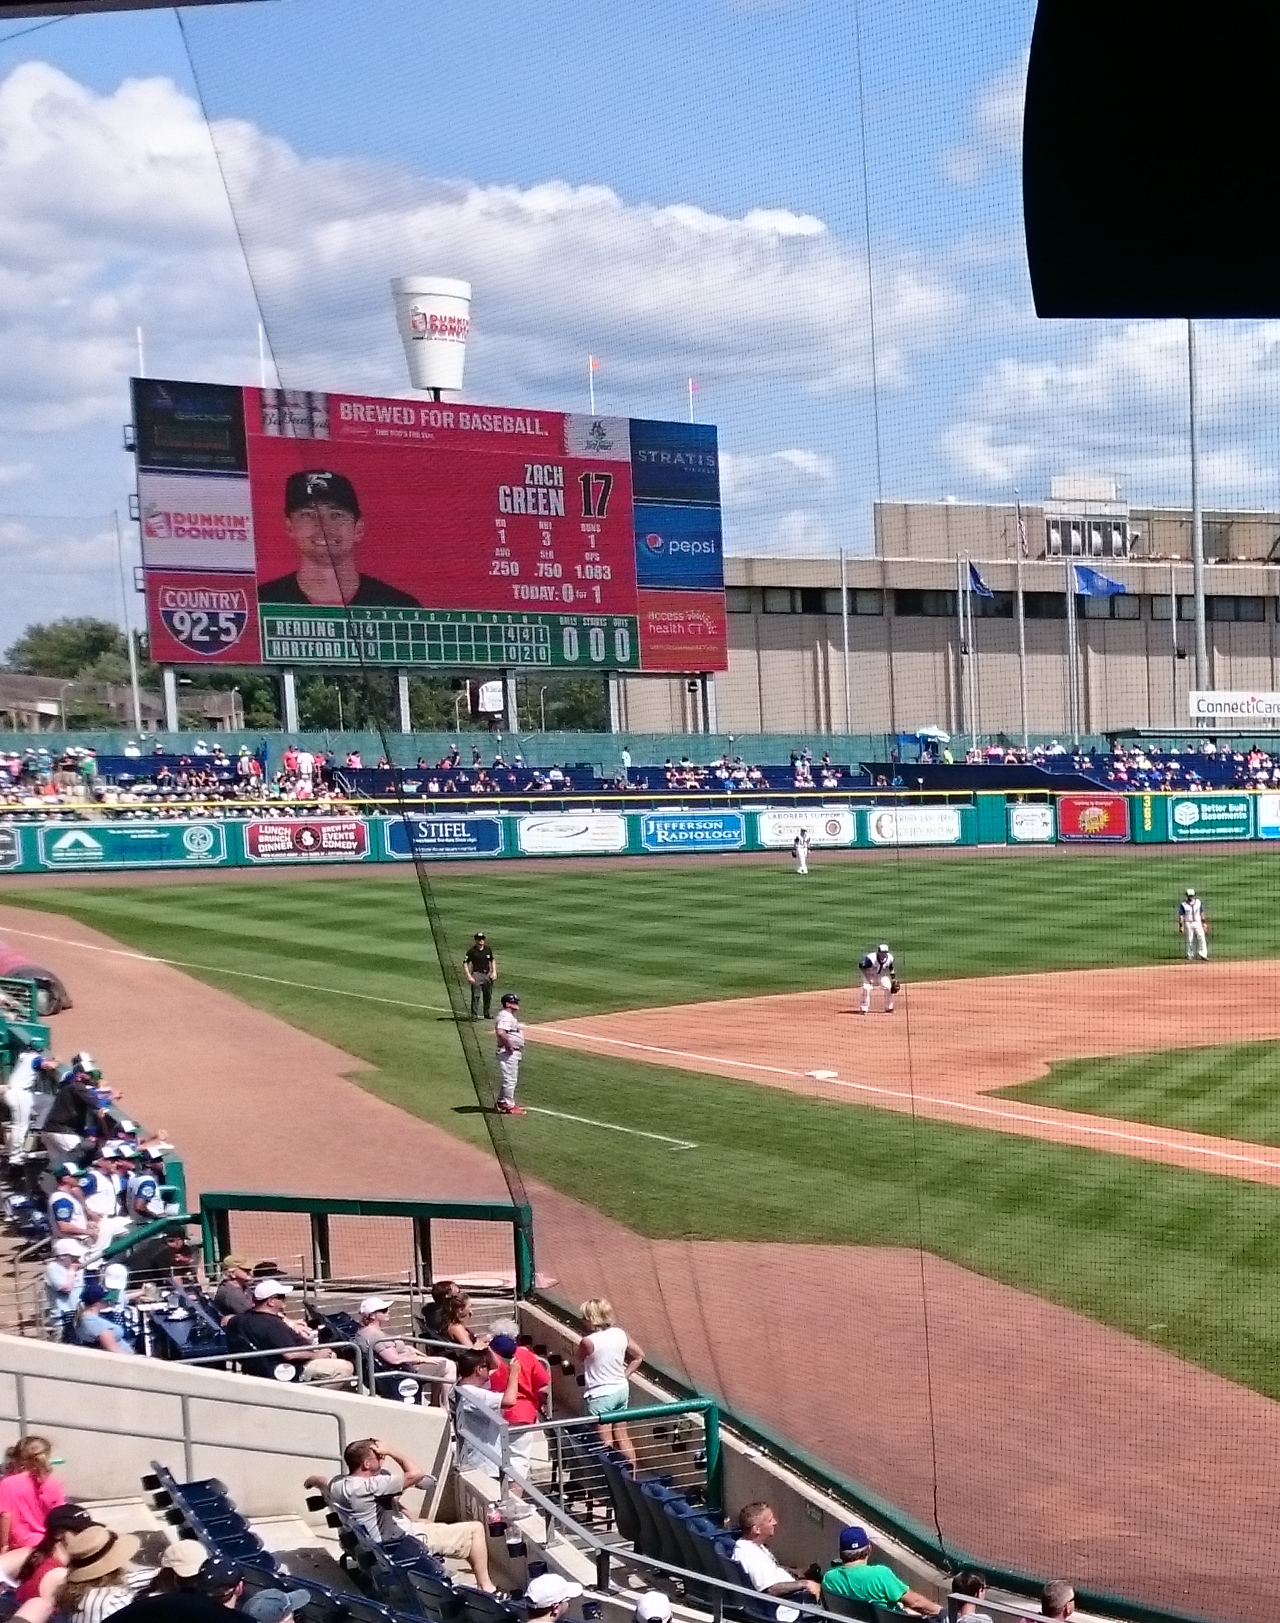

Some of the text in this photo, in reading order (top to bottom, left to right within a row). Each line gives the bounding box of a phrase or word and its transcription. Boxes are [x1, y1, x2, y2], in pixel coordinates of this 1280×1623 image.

[339, 402, 415, 426] BREWED
[420, 409, 455, 429] FOR
[459, 411, 549, 436] BASEBALL.
[638, 450, 716, 467] STRATIS
[524, 463, 564, 487] ZACH
[498, 485, 566, 517] GREEN
[578, 471, 614, 518] 17
[172, 512, 249, 528] DUNKIN'
[175, 528, 248, 542] DONUTS
[498, 529, 596, 549] 1 3 1
[669, 539, 715, 556] pepsi
[488, 561, 563, 579] .250 .750
[164, 590, 241, 610] COUNTRY
[511, 583, 602, 604] TODAY: 0 1
[172, 611, 239, 642] 92-5
[275, 620, 544, 642] READING 4 4 4 1
[649, 621, 704, 635] health CT
[271, 641, 546, 661] HARTFORD 0 2 0
[562, 626, 631, 663] 0 0 0
[1201, 803, 1247, 812] Better Built
[767, 812, 845, 820] LABORERS SUPPORT
[1201, 812, 1247, 821] Basements
[259, 825, 291, 836] LUNCH
[342, 823, 356, 831] PUB
[418, 821, 471, 837] STIFEL
[646, 820, 724, 835] JEFFERSON
[258, 834, 291, 843] BRUNCH
[323, 831, 355, 841] EVENTS
[656, 829, 741, 843] RADIOLOGY
[258, 841, 293, 853] DINNER
[322, 840, 358, 849] COMEDY
